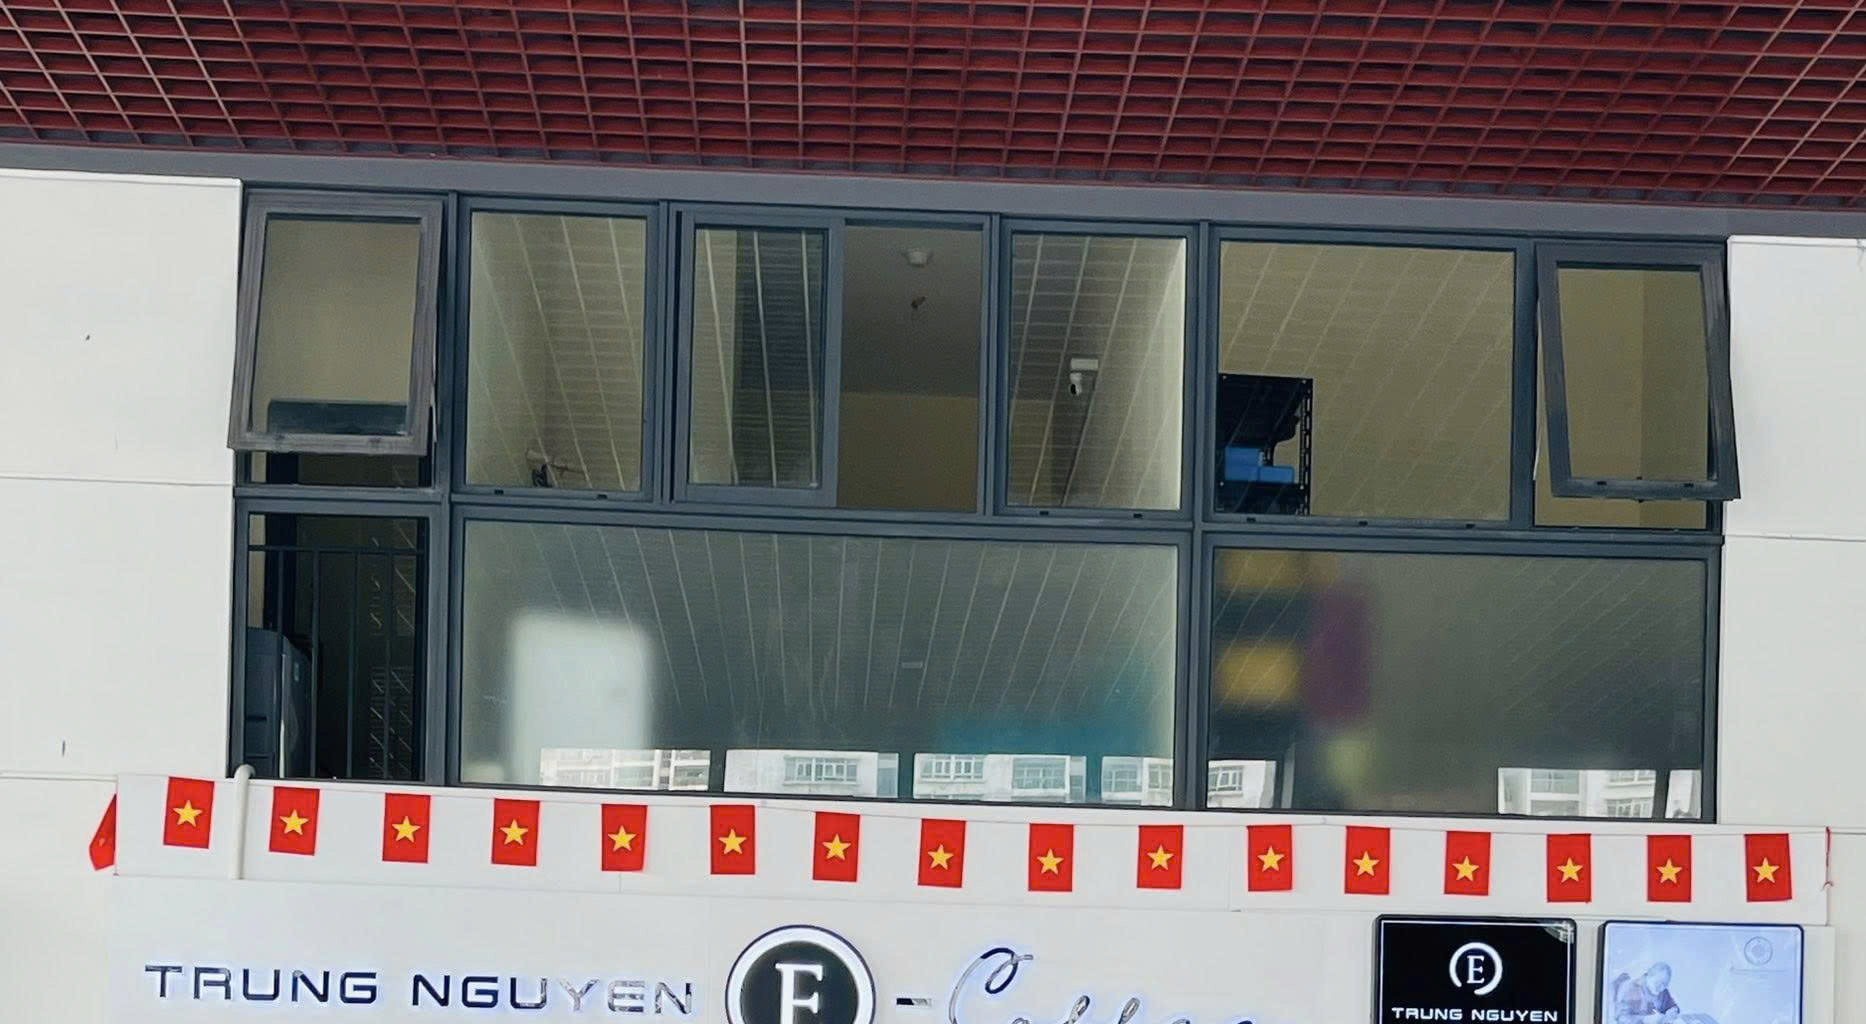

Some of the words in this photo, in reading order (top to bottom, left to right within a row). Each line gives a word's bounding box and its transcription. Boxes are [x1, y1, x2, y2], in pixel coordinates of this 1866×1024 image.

[1466, 955, 1485, 984] E
[144, 965, 378, 1004] TRUNG
[411, 974, 693, 1015] NGUYEN
[1392, 1007, 1463, 1020] TRUNG
[1471, 1009, 1558, 1022] NGUYEN
